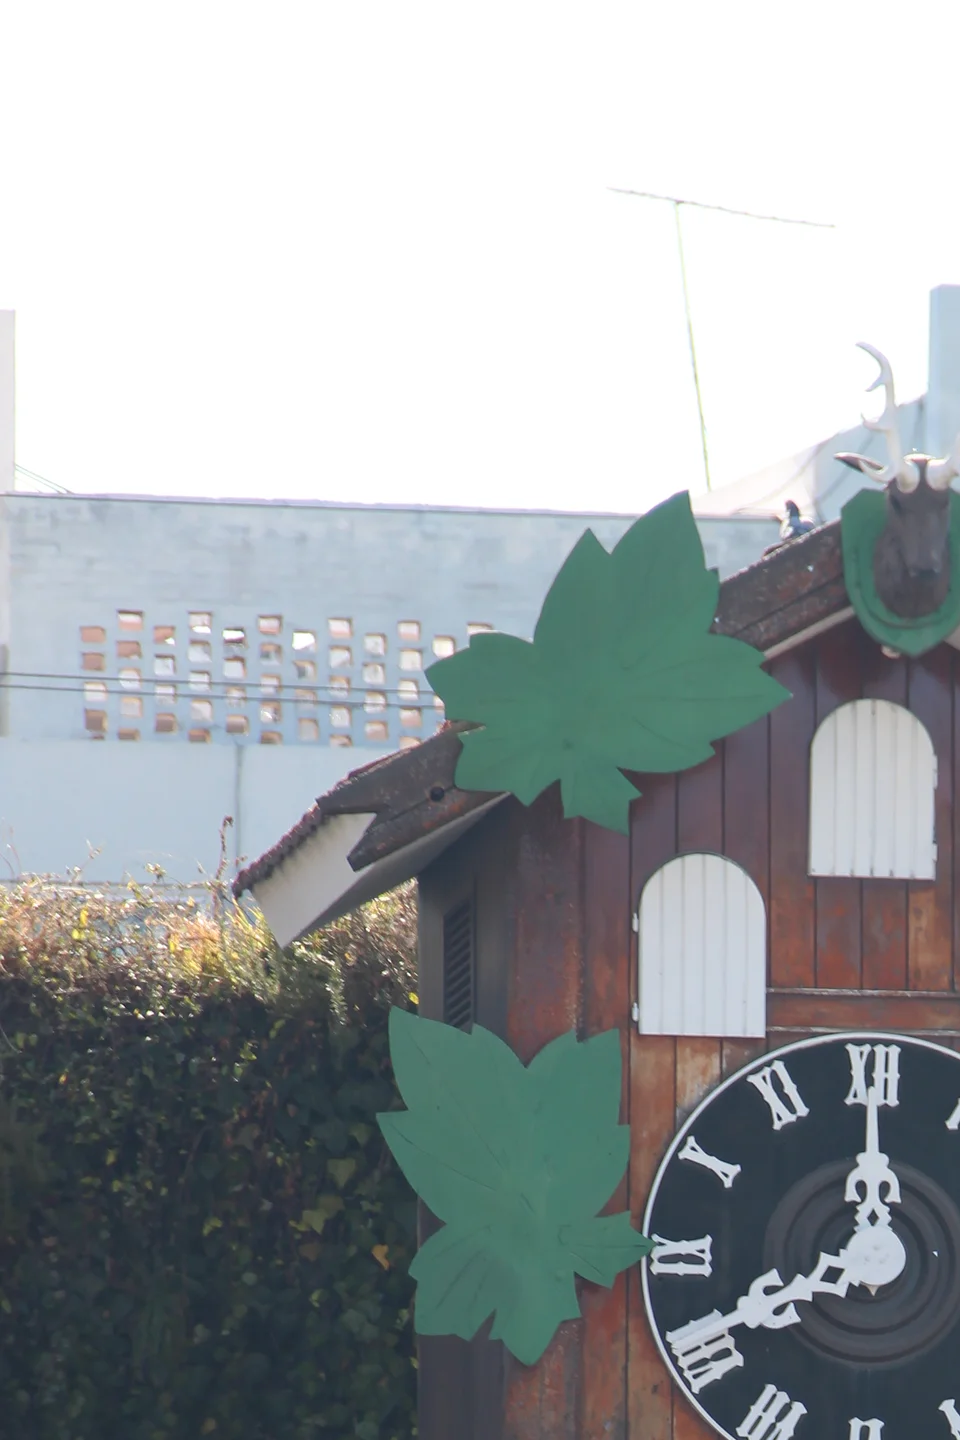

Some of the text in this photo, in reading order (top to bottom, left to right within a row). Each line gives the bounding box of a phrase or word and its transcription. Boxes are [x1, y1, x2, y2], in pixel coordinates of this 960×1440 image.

[747, 1060, 809, 1131] XI
[845, 1042, 901, 1107] XII
[678, 1135, 742, 1188] X
[650, 1233, 713, 1278] IX
